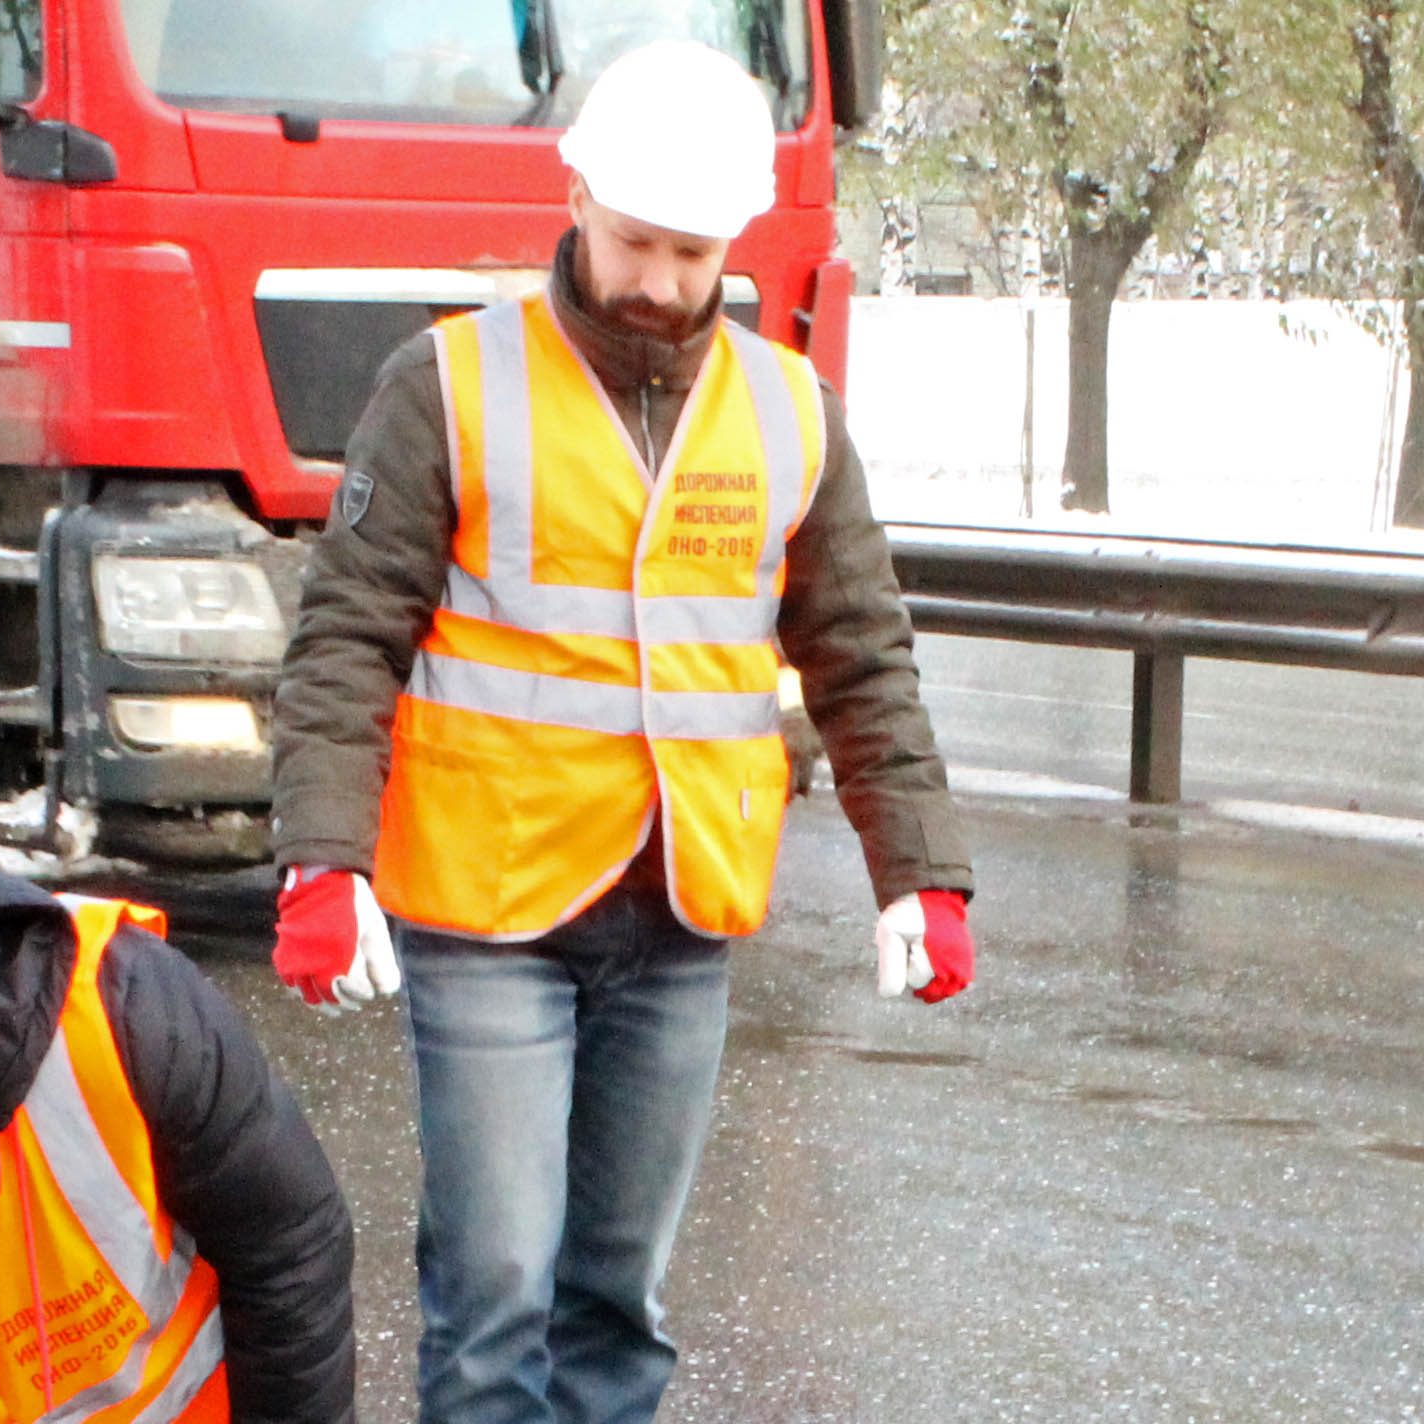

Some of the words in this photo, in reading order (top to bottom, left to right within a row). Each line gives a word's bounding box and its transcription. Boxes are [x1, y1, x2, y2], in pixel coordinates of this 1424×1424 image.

[674, 473, 757, 494] ДОРОЖНАЯ
[674, 504, 757, 525] ИНСПЕКЦИЯ
[667, 536, 754, 557] ОНФ-2015
